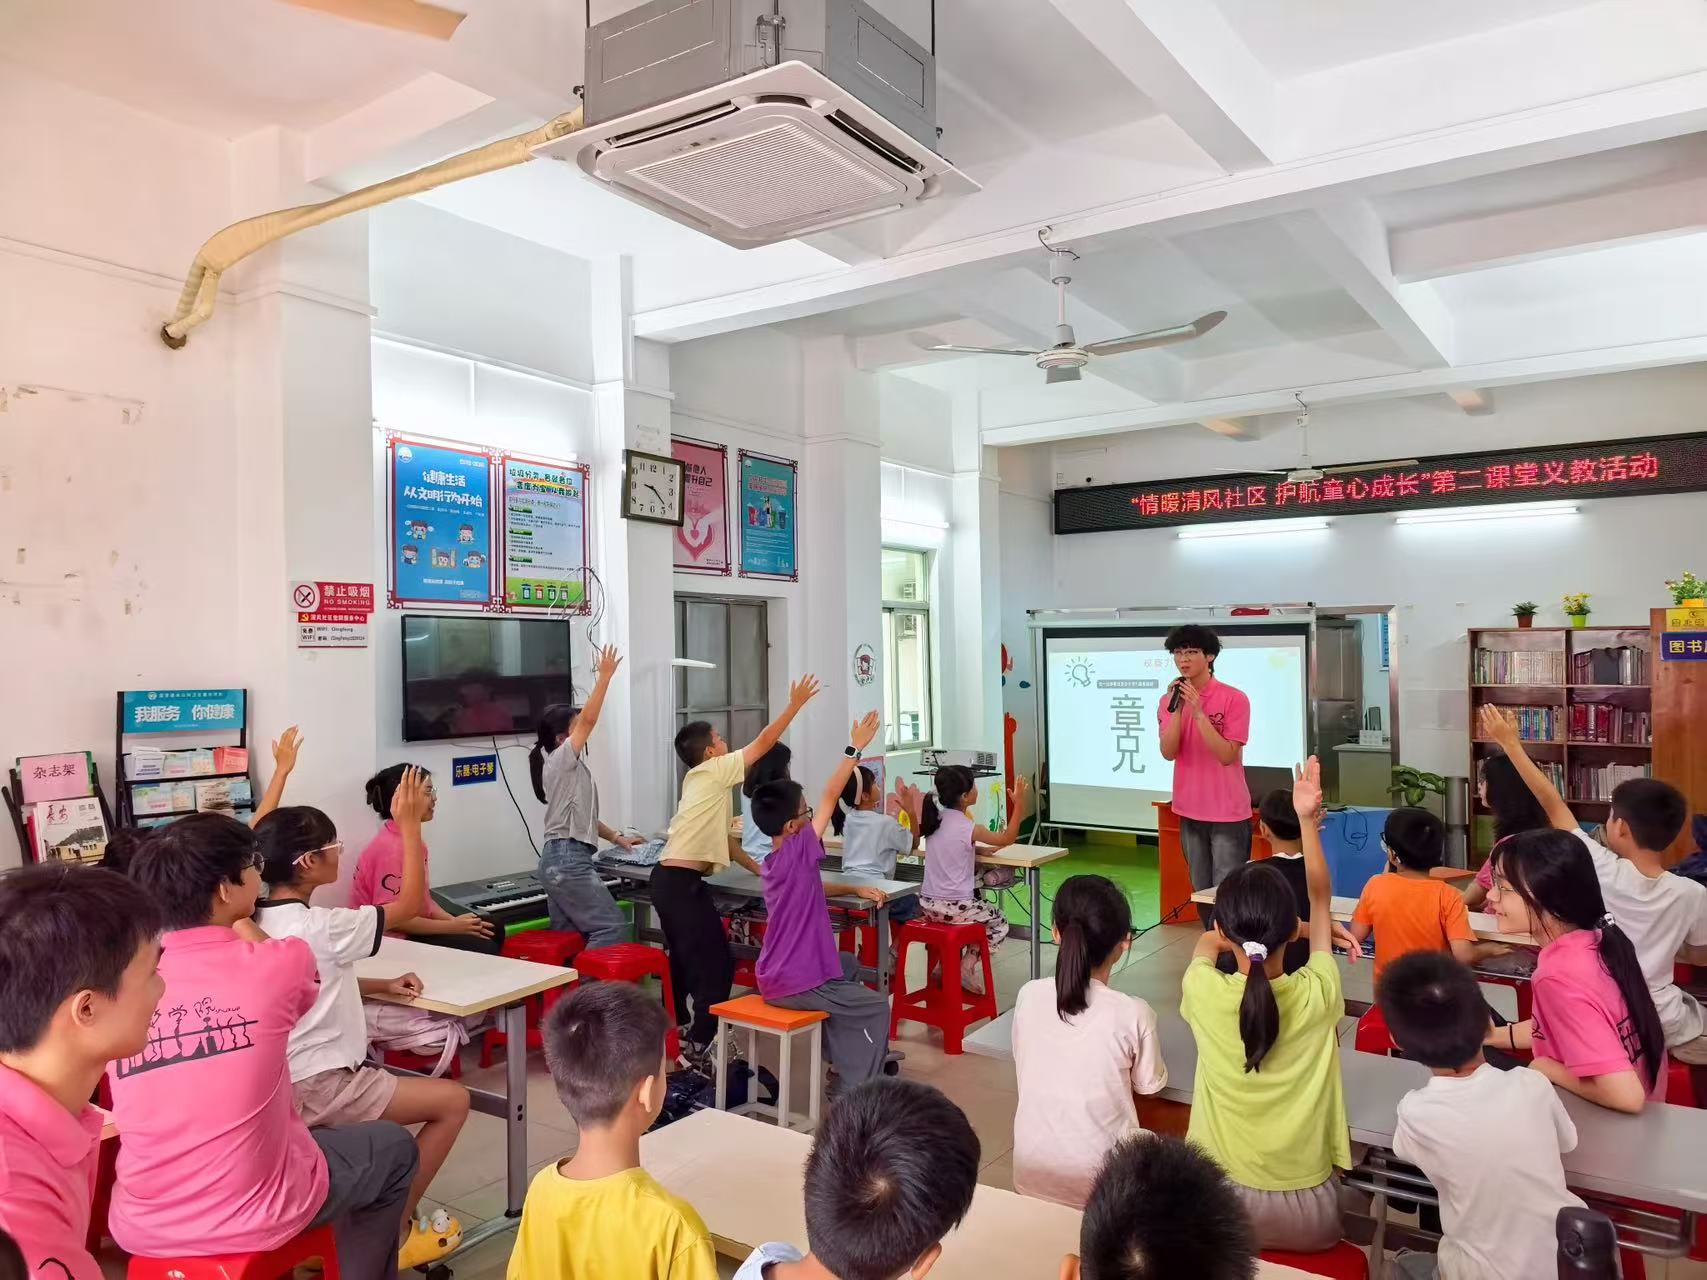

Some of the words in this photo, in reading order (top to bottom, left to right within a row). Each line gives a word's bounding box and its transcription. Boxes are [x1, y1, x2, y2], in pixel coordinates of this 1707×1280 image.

[422, 469, 466, 487] 健康生活
[403, 485, 483, 508] 从文明行为开始
[324, 585, 370, 598] 禁止吸烟
[1669, 640, 1707, 654] 图书
[135, 705, 181, 723] 我服务
[192, 704, 235, 720] 你健康
[33, 763, 76, 779] 杂志架
